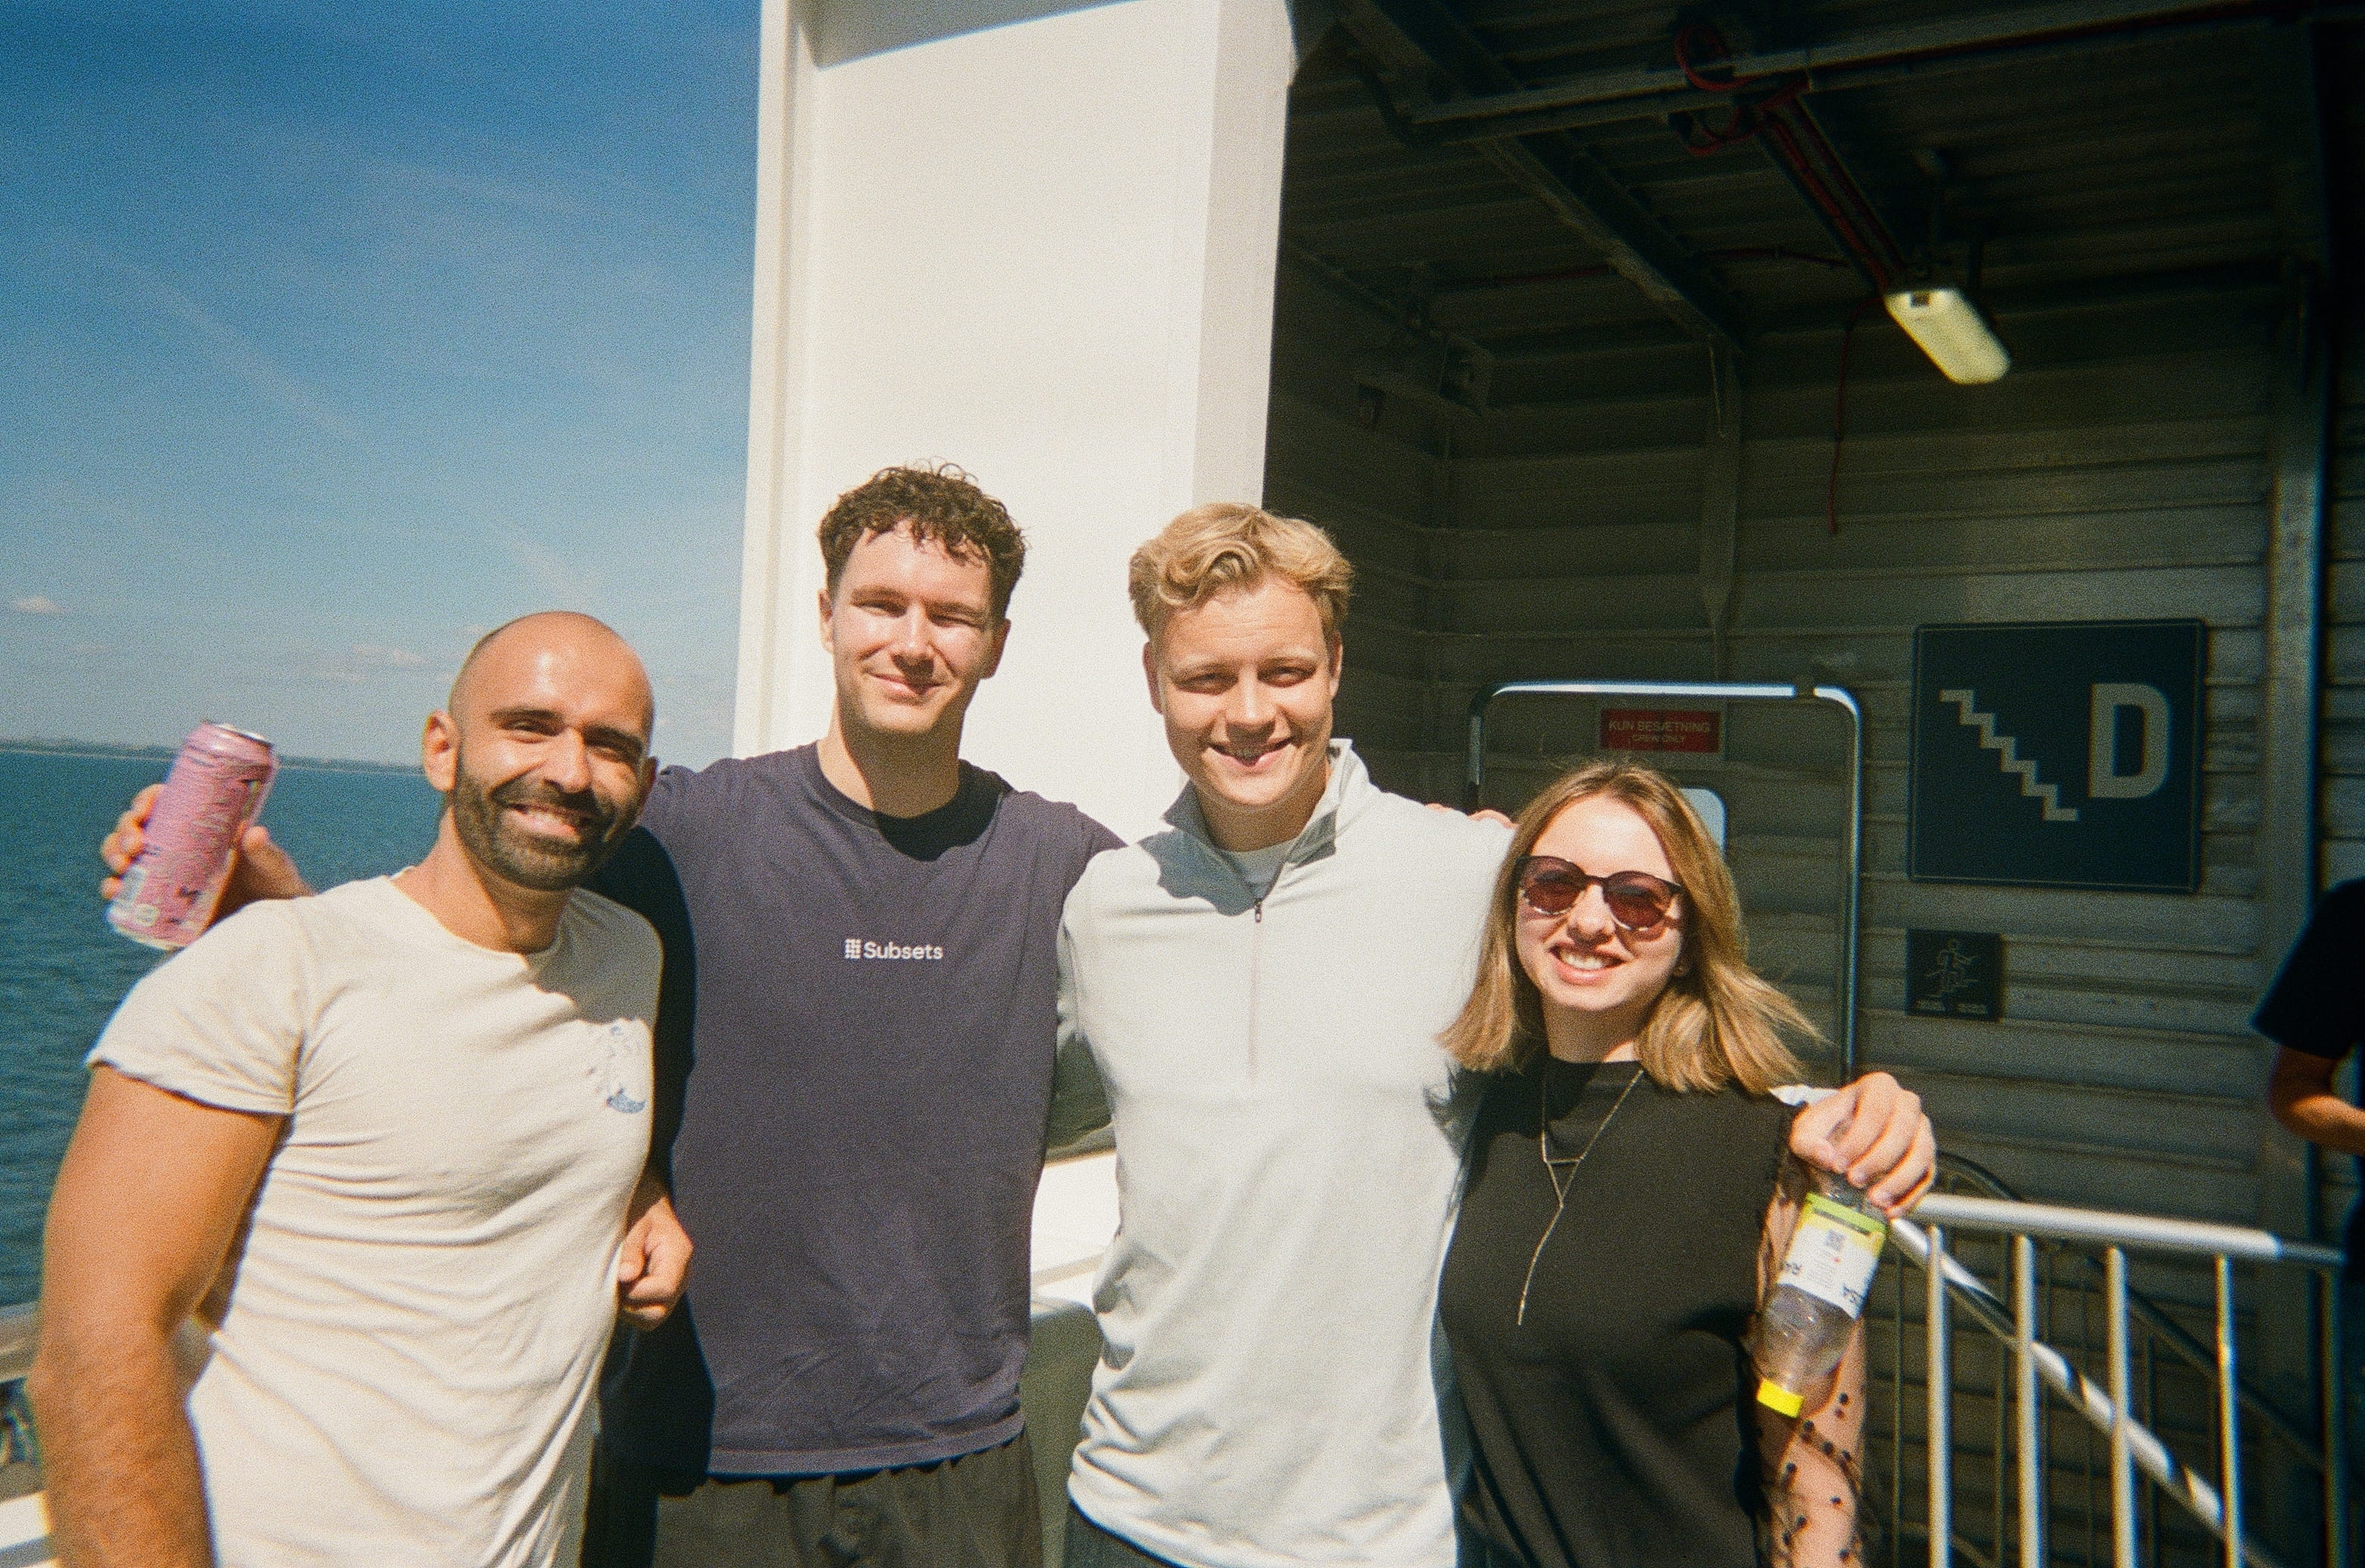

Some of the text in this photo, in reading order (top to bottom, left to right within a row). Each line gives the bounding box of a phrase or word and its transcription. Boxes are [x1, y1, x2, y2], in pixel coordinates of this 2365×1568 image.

[1608, 720, 1711, 733] KUN BESÆTNING
[2088, 682, 2172, 799] D
[863, 940, 944, 960] Subsets
